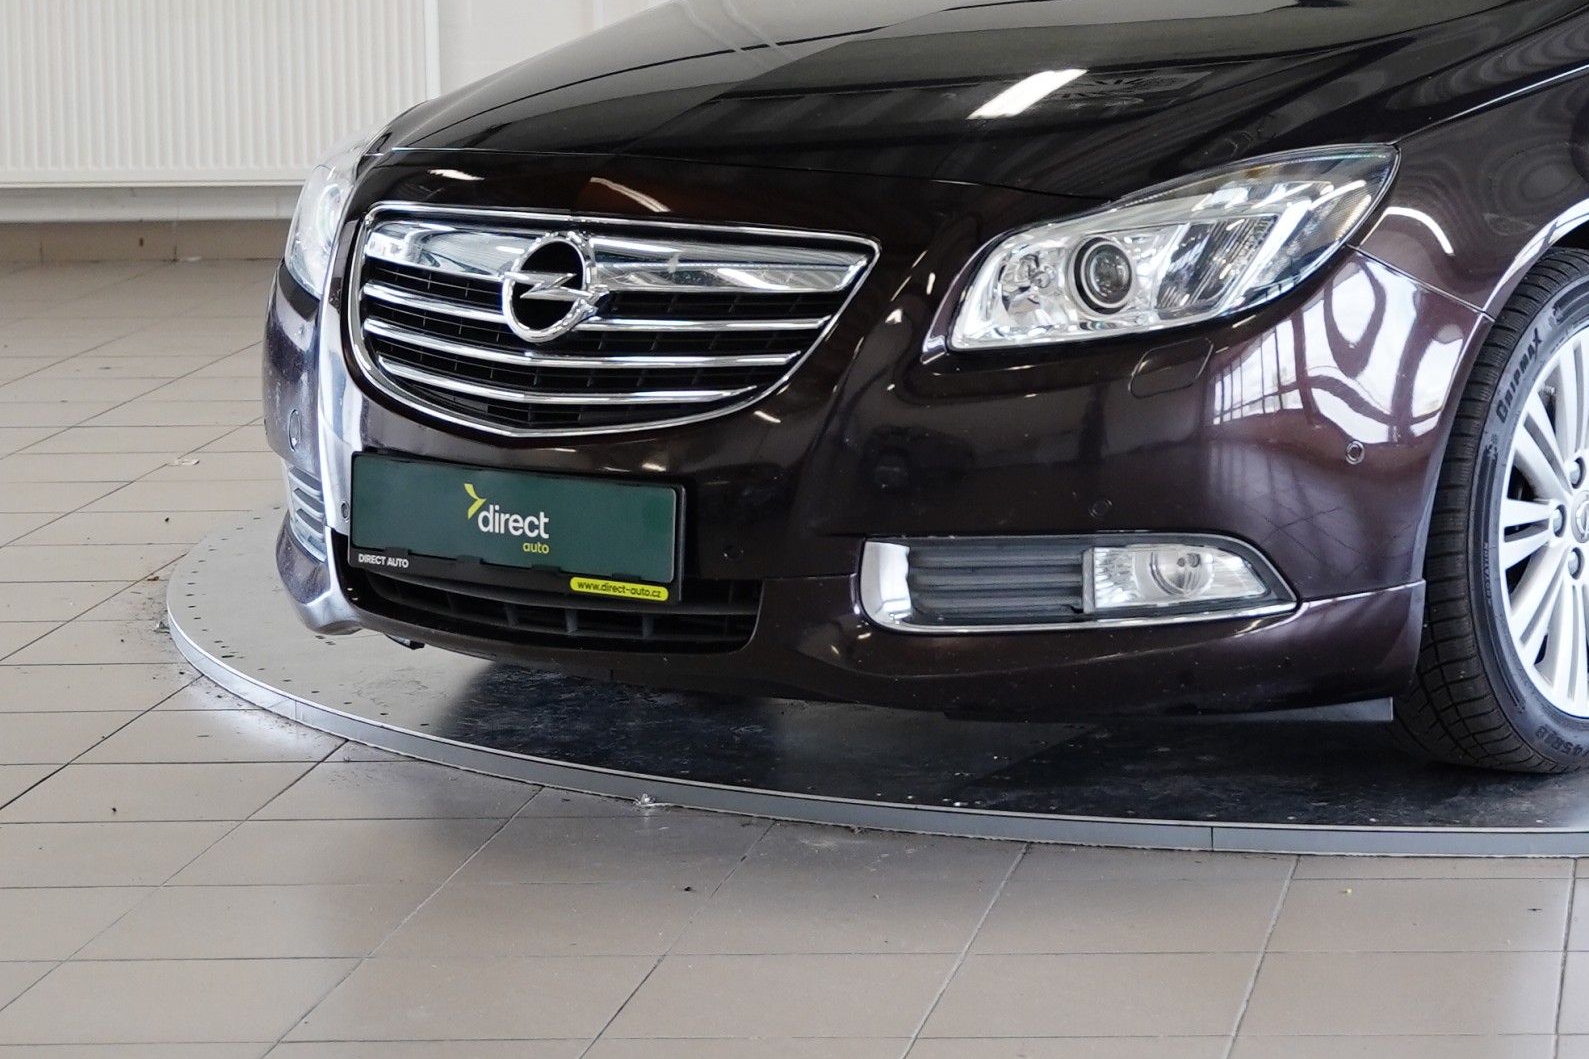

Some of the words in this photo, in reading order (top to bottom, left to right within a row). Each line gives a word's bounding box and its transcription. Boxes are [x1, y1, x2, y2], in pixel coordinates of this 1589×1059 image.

[477, 504, 550, 539] direct
[522, 541, 550, 555] auto
[358, 553, 387, 566] DIRECT
[387, 555, 409, 568] AUTO
[577, 580, 662, 599] www.direct-auto.cz
